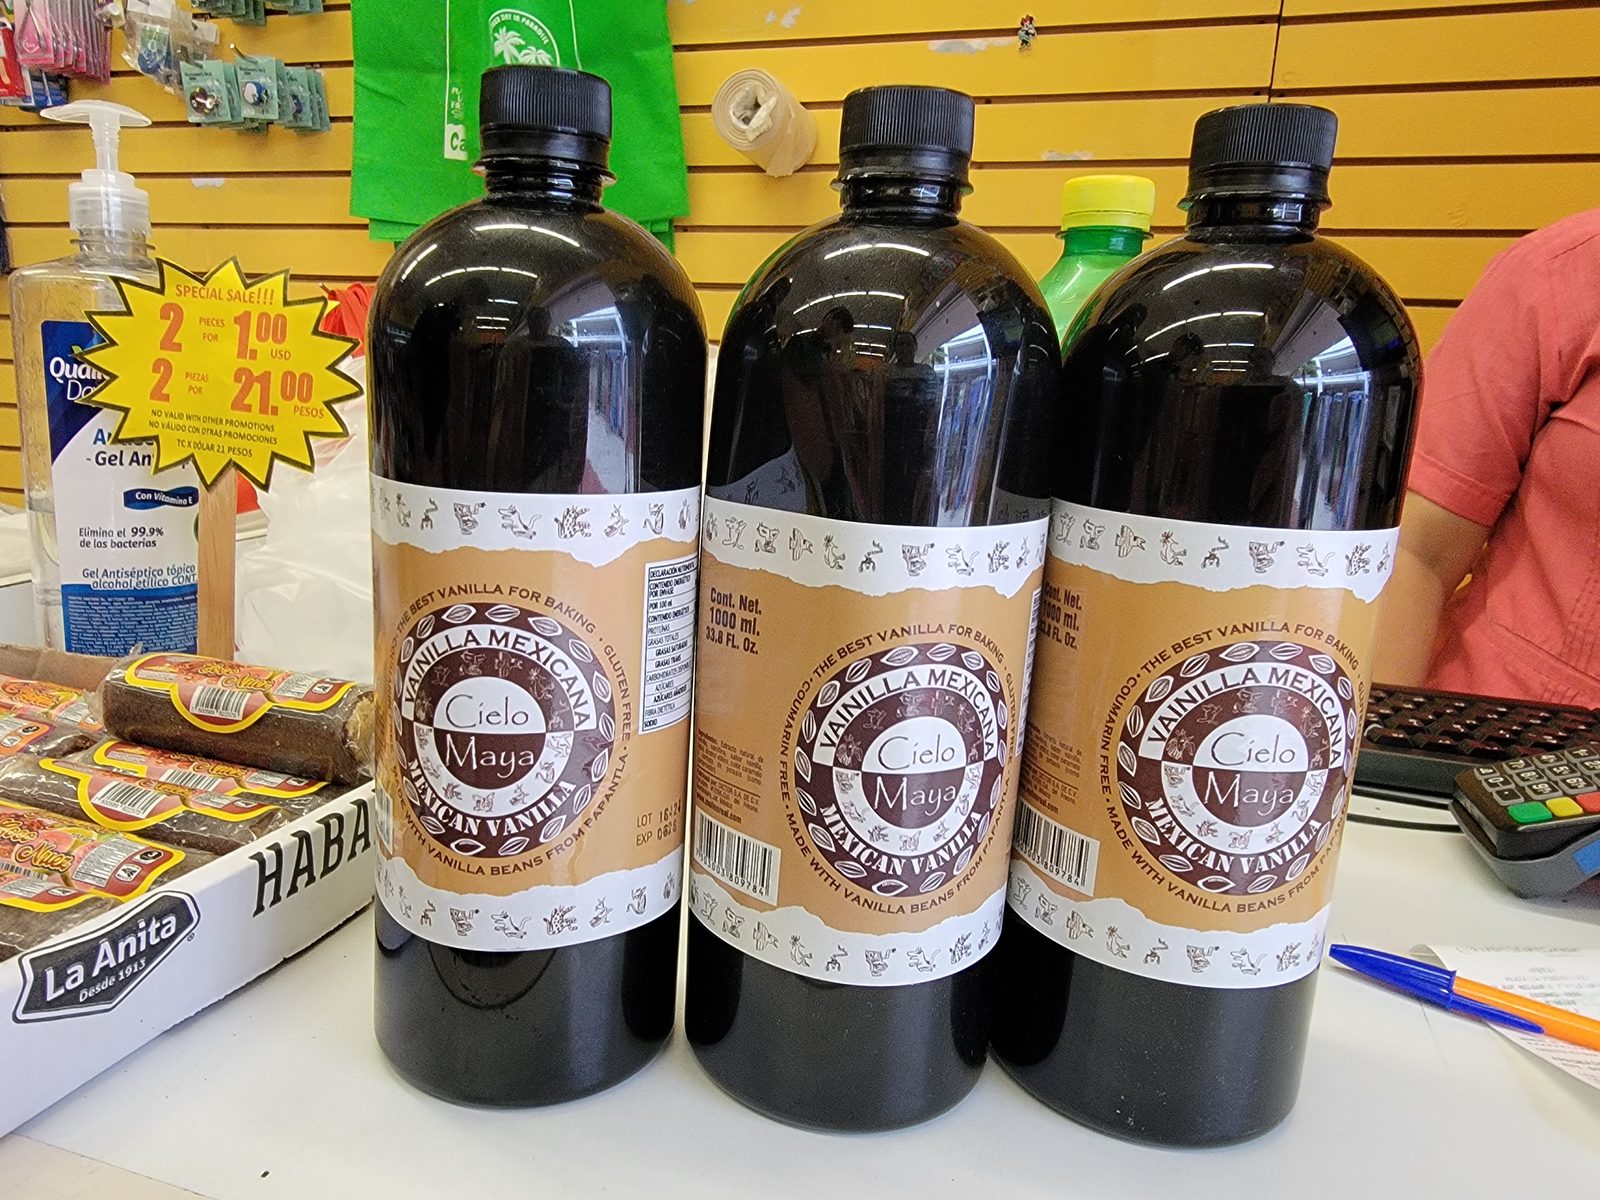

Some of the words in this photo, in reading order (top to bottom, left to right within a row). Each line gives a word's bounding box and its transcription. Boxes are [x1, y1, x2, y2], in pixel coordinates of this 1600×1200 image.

[175, 284, 224, 301] SPECIAL
[226, 287, 275, 306] SALE!!!
[159, 301, 185, 352] 2
[199, 316, 225, 328] PIECES
[233, 310, 288, 361] 1.00
[202, 332, 219, 343] FOR
[270, 348, 292, 361] USD
[149, 357, 173, 403] 2
[184, 371, 209, 383] PIEZAS
[230, 366, 314, 417] 21.00
[187, 384, 203, 395] POR
[293, 404, 325, 419] PESOS
[148, 420, 160, 430] NO
[160, 420, 187, 433] VÁLIDO
[187, 425, 201, 434] CON
[201, 426, 223, 438] OTRAS
[223, 430, 278, 445] PROMOCIONES
[151, 408, 163, 418] NO
[164, 410, 185, 421] VALID
[185, 413, 202, 423] WITH
[202, 415, 224, 426] OTHER
[224, 418, 275, 433] PROMOTIONS
[94, 450, 124, 466] Gel
[176, 438, 187, 447] TC
[187, 440, 193, 448] X
[216, 444, 225, 454] 21
[227, 446, 253, 458] PESOS
[135, 491, 152, 501] Con
[153, 492, 187, 505] Vitamina
[188, 496, 193, 504] E
[79, 526, 114, 538] Elimina
[117, 528, 126, 538] el
[131, 526, 165, 538] 99.9%
[79, 539, 91, 548] de
[93, 539, 108, 548] las
[110, 538, 157, 548] bacterias
[82, 567, 99, 578] Gel
[101, 566, 164, 582] Antiséptico
[166, 563, 196, 577] tópico
[92, 578, 133, 589] alcohol
[135, 576, 169, 588] etílico
[710, 587, 735, 609] Cont.
[739, 594, 762, 615] Net.
[1063, 588, 1082, 611] Net.
[705, 625, 723, 645] 33.8
[726, 631, 740, 650] FL.
[743, 636, 758, 655] Oz.
[710, 606, 737, 629] 1000
[740, 617, 760, 636] ml.
[1063, 612, 1080, 632] ml.
[1064, 631, 1078, 650] Oz.
[396, 610, 411, 634] THE
[409, 591, 435, 616] BEST
[437, 583, 504, 599] VANILLA
[508, 585, 542, 603] FOR
[543, 595, 597, 634] BAKING
[603, 644, 630, 703] GLUTEN
[622, 702, 632, 742] FREE
[812, 653, 838, 679] THE
[837, 634, 874, 660] BEST
[876, 623, 945, 642] VANILLA
[948, 624, 973, 639] FOR
[973, 631, 1005, 665] BAKING
[1140, 649, 1172, 675] THE
[1170, 629, 1214, 656] BEST
[1216, 621, 1291, 638] VANILLA
[1294, 623, 1324, 641] FOR
[1324, 634, 1360, 671] BAKING
[404, 629, 482, 703] VAINILLA
[487, 629, 592, 729] MEXICANA
[445, 693, 529, 729] Cielo
[780, 680, 811, 757] COUMARIN
[819, 671, 921, 750] VAINILLA
[927, 668, 995, 757] MEXICANA
[1100, 676, 1138, 752] COUMARIN
[1147, 667, 1261, 743] VAINILLA
[1267, 666, 1343, 766] MEXICANA
[445, 732, 534, 779] Maya
[878, 733, 955, 771] Cielo
[1211, 731, 1296, 767] Cielo
[779, 762, 791, 802] FREE
[1100, 755, 1112, 795] FREE
[1203, 770, 1294, 817] Maya
[405, 811, 426, 846] WITH
[427, 844, 486, 876] VANILLA
[490, 855, 544, 876] BEANS
[546, 826, 585, 861] FROM
[583, 752, 629, 830] PAPANTLA
[408, 757, 482, 836] MEXICAN
[486, 780, 577, 837] VANILLA
[874, 775, 957, 816] Maya
[636, 812, 653, 828] LOT
[636, 830, 653, 846] EXP
[820, 802, 906, 876] MEXICAN
[910, 811, 983, 876] VANILLA
[1144, 797, 1235, 873] MEXICAN
[1240, 819, 1322, 875] VANILLA
[248, 797, 375, 918] HABA
[786, 812, 812, 858] MADE
[809, 857, 842, 892] WITH
[843, 887, 906, 915] VANILLA
[910, 889, 955, 914] BEANS
[956, 857, 984, 891] FROM
[1106, 806, 1135, 851] MADE
[1131, 849, 1166, 886] WITH
[1167, 882, 1233, 913] VANILLA
[1236, 894, 1286, 913] BEANS
[1288, 865, 1320, 899] FROM
[728, 872, 764, 896] 809784
[44, 963, 85, 1001] La
[92, 914, 177, 977] Anita
[79, 975, 116, 1003] Desde
[118, 957, 146, 982] 1913
